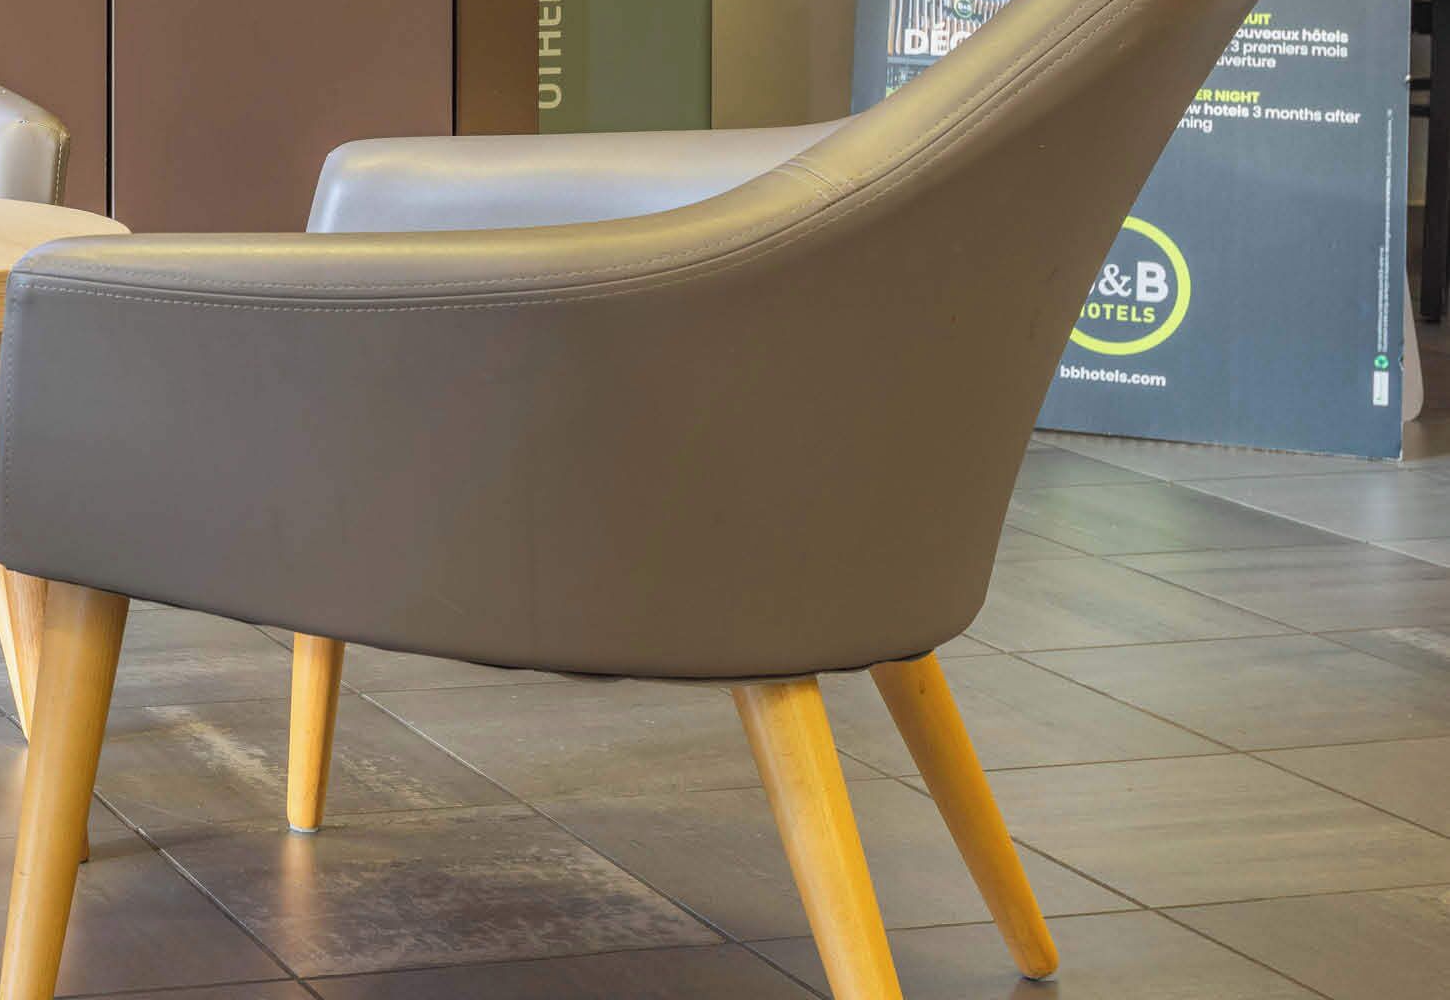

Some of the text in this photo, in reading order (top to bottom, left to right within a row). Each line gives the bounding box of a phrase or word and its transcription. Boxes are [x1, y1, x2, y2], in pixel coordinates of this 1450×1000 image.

[1236, 27, 1349, 43] ouveaux hôtels
[1231, 41, 1348, 58] 3 premiers mois
[1216, 54, 1277, 69] uverture
[1215, 90, 1261, 104] NIGHT
[1204, 102, 1250, 118] hotels
[1252, 106, 1262, 118] 3
[1264, 107, 1322, 122] months
[1324, 109, 1361, 124] after
[1090, 261, 1169, 303] &B
[1060, 364, 1167, 387] bbhotels.com
